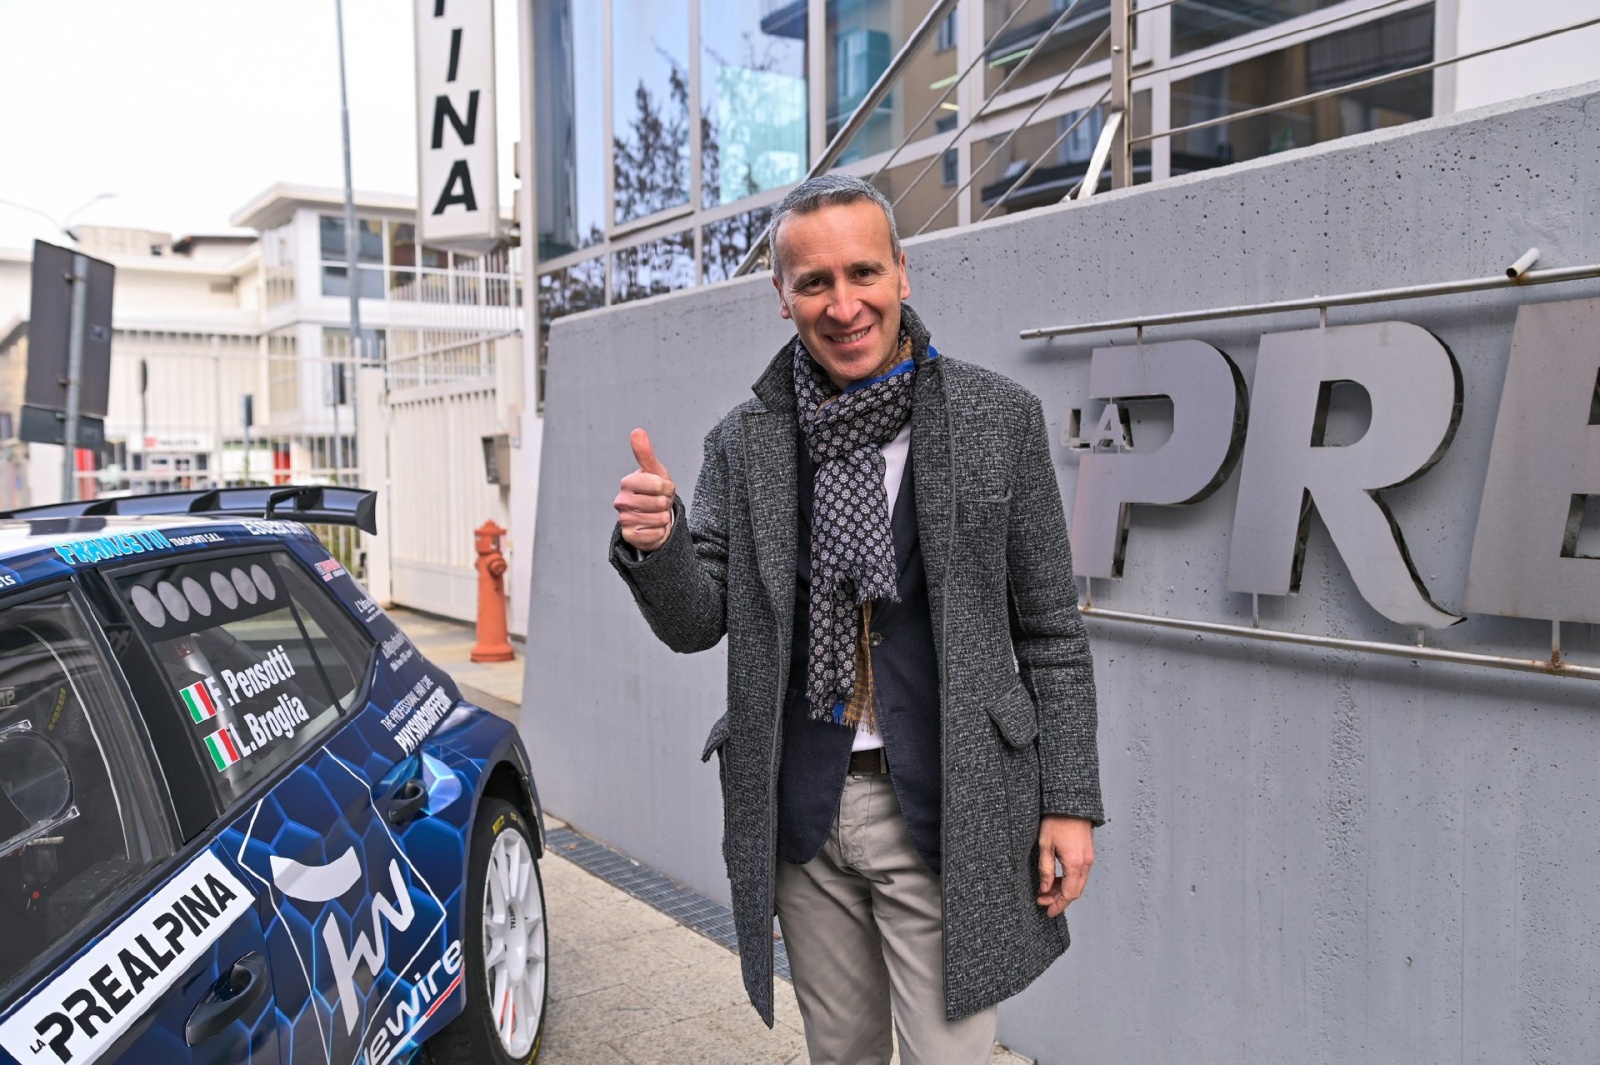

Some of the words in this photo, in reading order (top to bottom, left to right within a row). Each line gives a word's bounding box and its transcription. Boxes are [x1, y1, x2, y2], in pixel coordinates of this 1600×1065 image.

[1061, 403, 1134, 450] LA
[55, 530, 171, 565] FRANZETTI
[169, 534, 209, 546] TRASPORTI
[413, 682, 428, 698] HAIR
[420, 674, 434, 690] CARE
[389, 690, 420, 724] PROFESSIONAL
[380, 715, 396, 732] THE
[34, 873, 238, 1064] PREALPINA
[364, 940, 463, 1065] ewire
[29, 1038, 46, 1055] LA
